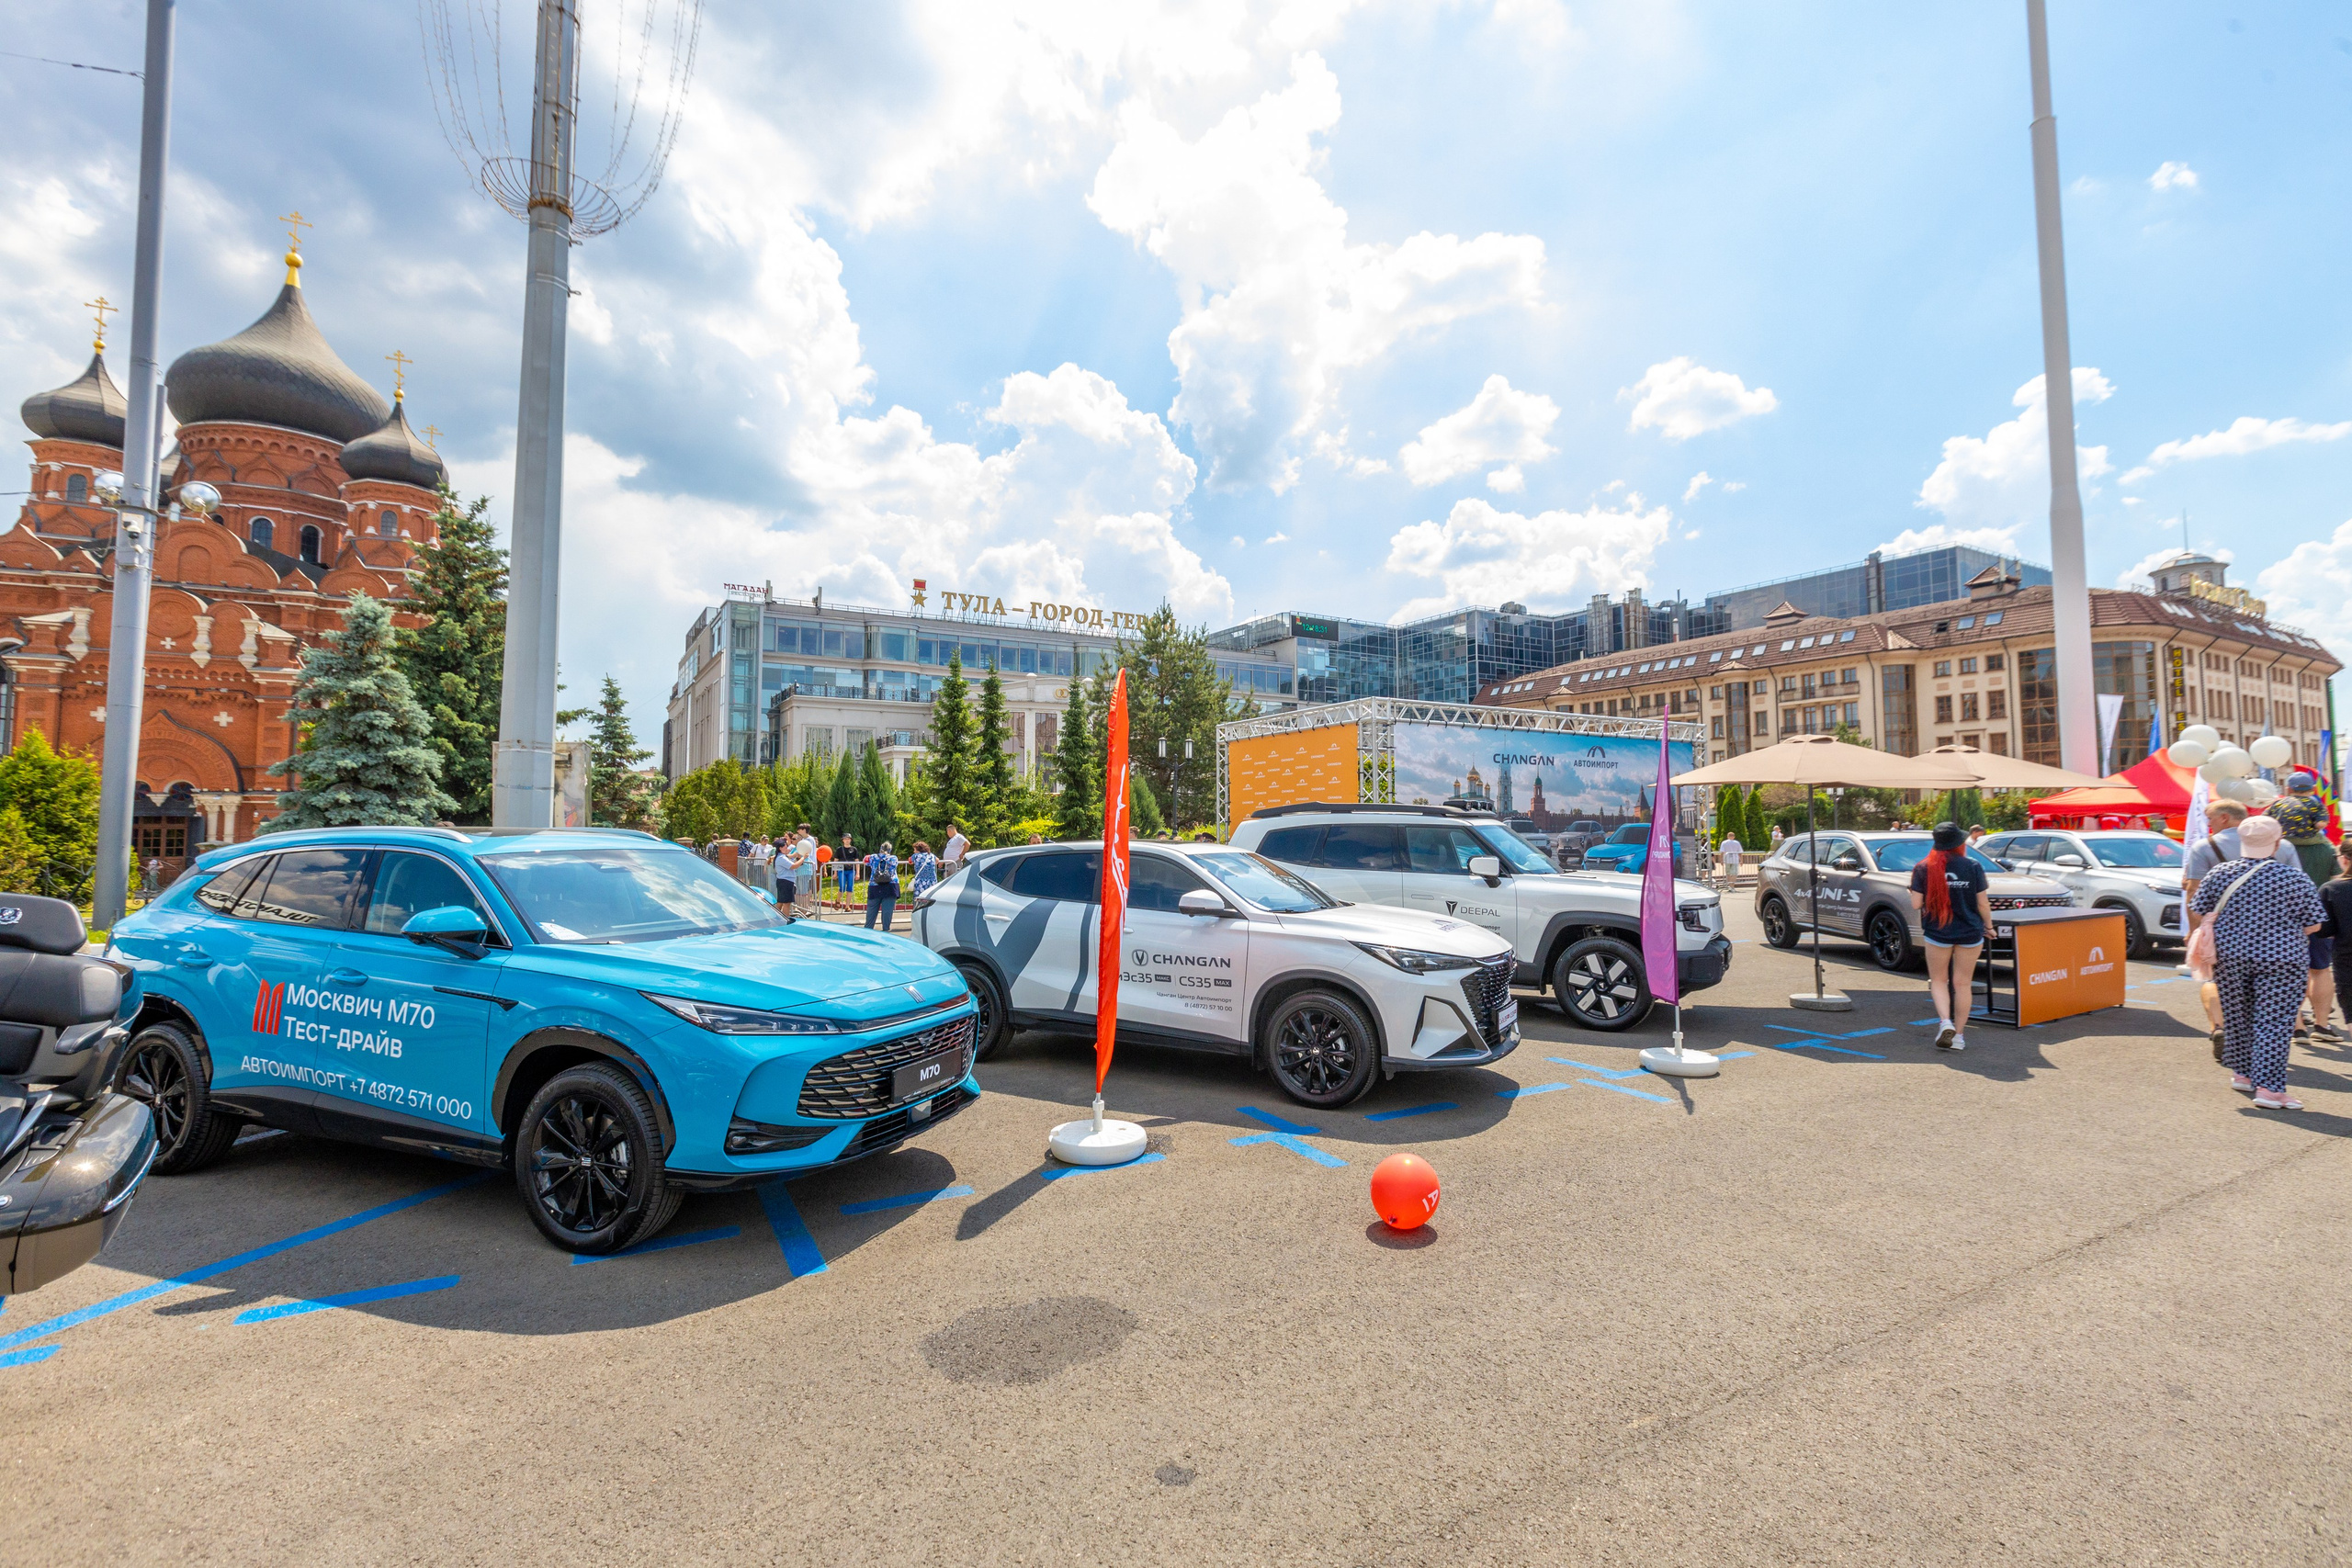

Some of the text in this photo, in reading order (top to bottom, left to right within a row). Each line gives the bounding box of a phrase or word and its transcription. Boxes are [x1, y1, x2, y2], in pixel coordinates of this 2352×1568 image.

[723, 583, 769, 593] МАГАДАН
[941, 591, 1007, 615] ТУЛА
[1030, 602, 1177, 634] ГОРОД-ГЕР
[2173, 649, 2184, 697] HOTEL
[1493, 753, 1555, 766] CHANGAN
[1574, 760, 1619, 769] АВТОИМПОРТ
[1815, 886, 1862, 903] UNI-S
[1460, 906, 1501, 917] DEEPAL
[1152, 953, 1231, 968] CHANGAN
[1179, 976, 1212, 988] CS35
[2029, 968, 2068, 986] CHANGAN
[1196, 995, 1232, 1003] Автоимпорт
[388, 999, 435, 1029] М70
[920, 1064, 941, 1081] M70
[241, 1055, 472, 1120] АВТОИМПОРТ +7 4872 571 000
